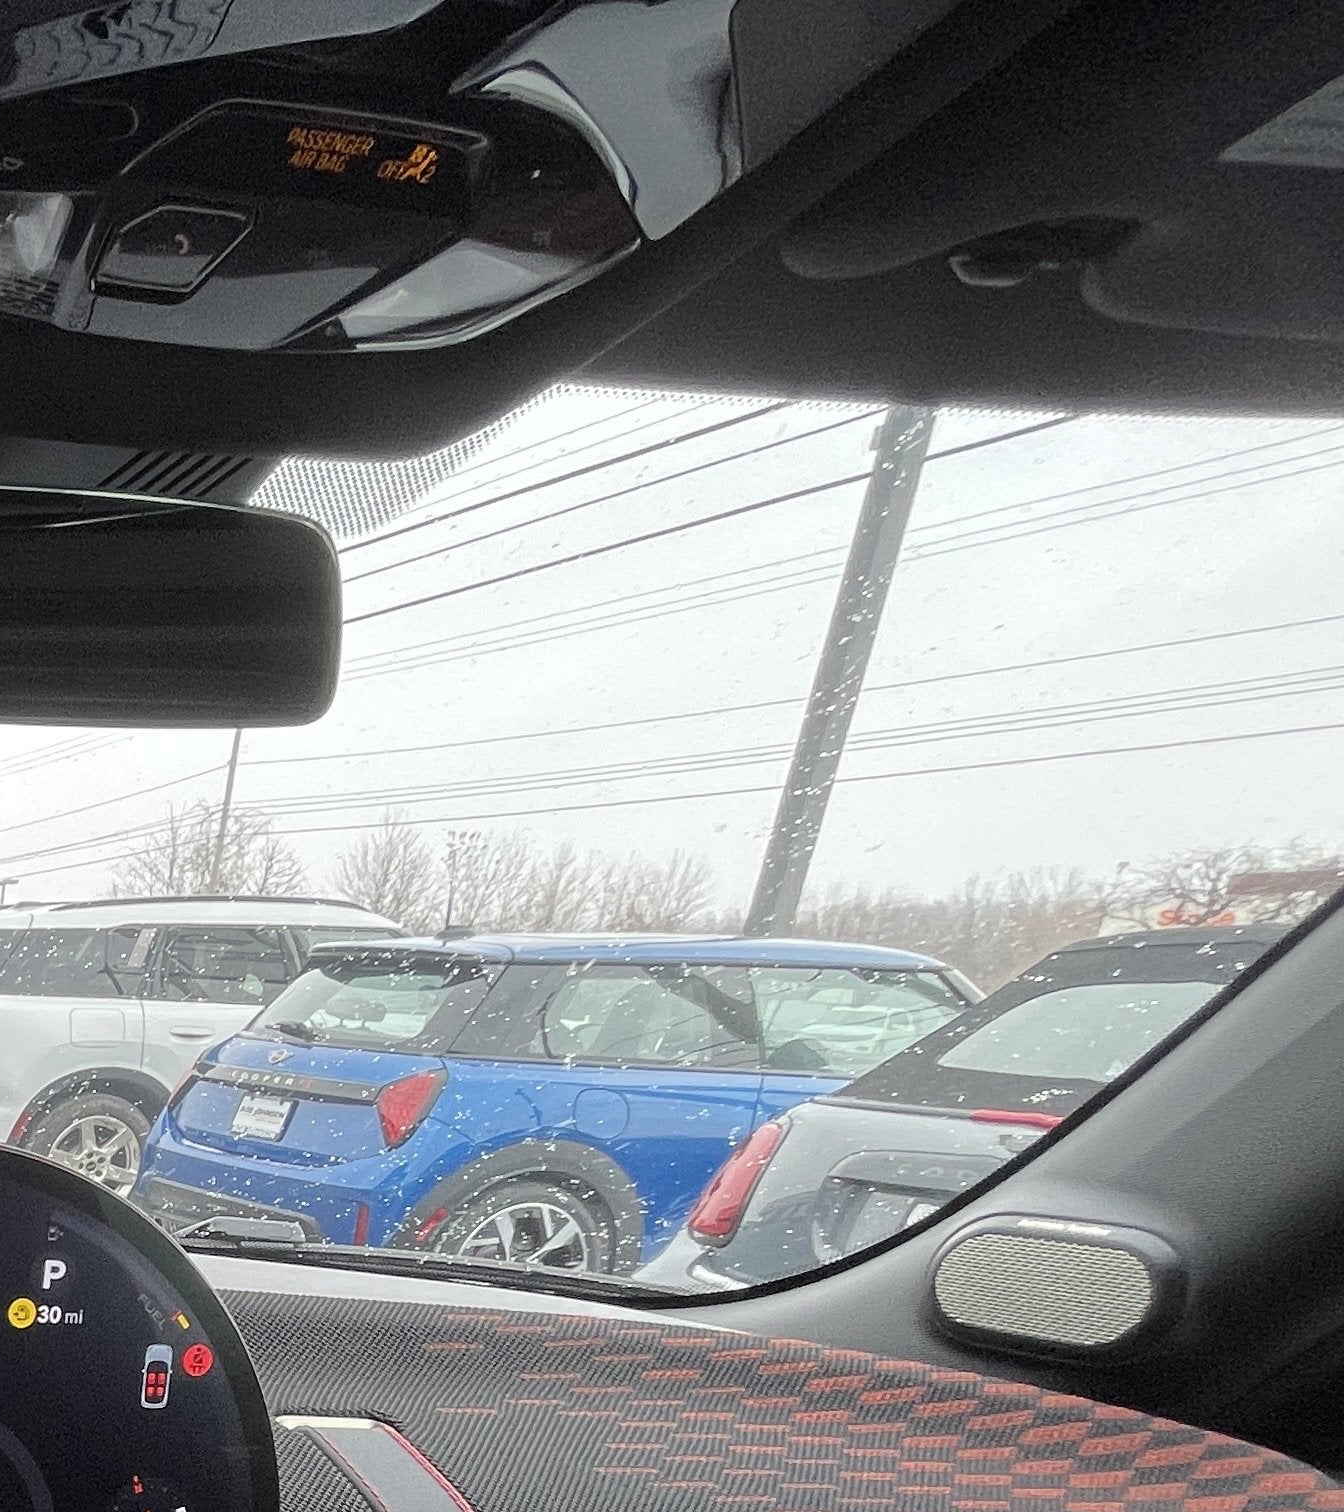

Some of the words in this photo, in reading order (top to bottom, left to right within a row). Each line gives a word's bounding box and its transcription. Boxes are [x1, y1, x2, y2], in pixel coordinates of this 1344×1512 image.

[287, 127, 375, 157] PASSENGER
[288, 149, 316, 168] AIR
[316, 153, 350, 173] BAG
[42, 1259, 67, 1290] P
[36, 1305, 63, 1325] 30
[64, 1309, 85, 1325] mi
[137, 1293, 168, 1329] FUEL
